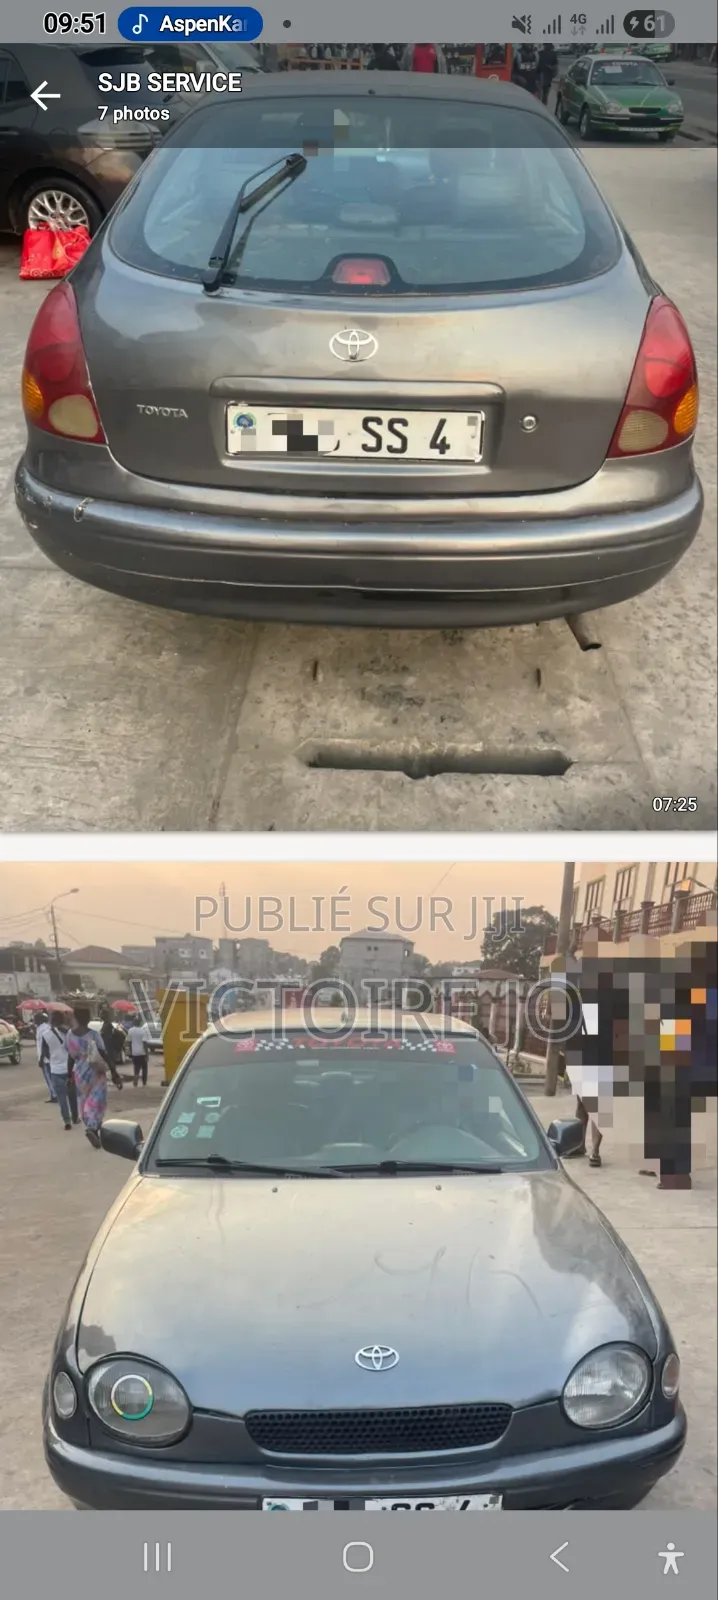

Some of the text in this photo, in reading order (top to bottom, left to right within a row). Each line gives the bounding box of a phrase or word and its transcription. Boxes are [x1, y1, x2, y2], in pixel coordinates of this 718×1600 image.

[136, 404, 189, 419] TOYOTA
[361, 416, 409, 454] SS
[429, 418, 451, 455] 4
